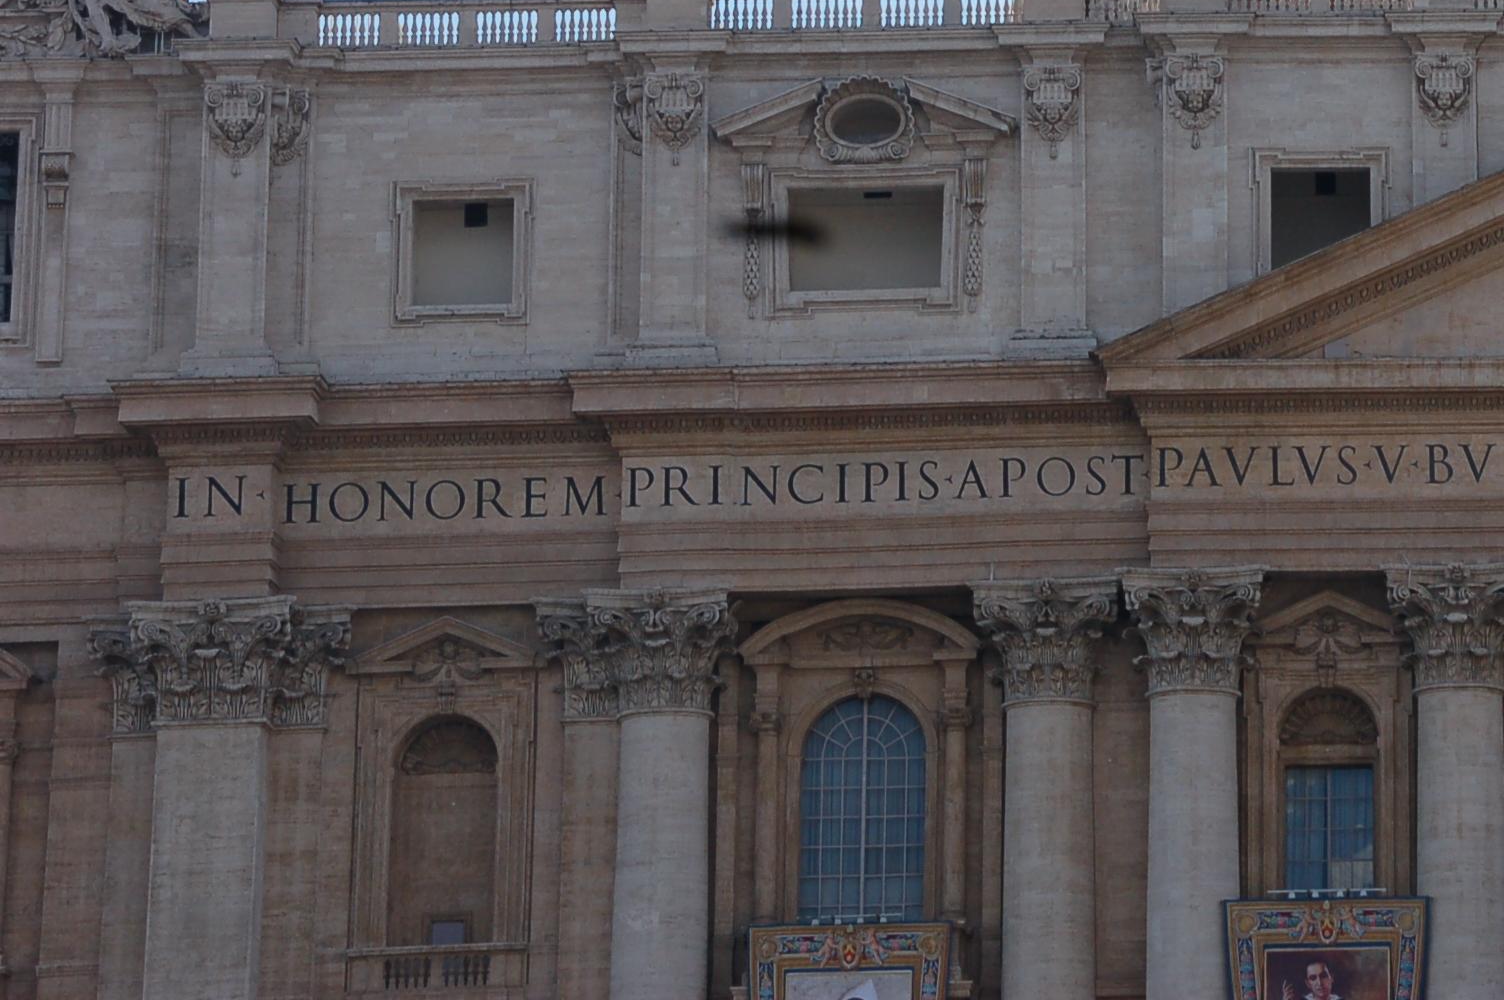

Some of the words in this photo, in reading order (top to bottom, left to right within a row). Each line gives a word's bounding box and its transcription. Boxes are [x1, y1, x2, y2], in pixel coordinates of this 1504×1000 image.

[173, 475, 247, 519] IN
[282, 475, 608, 525] HONOREM
[626, 460, 940, 508] PRINCIPIS
[952, 453, 1145, 498] APOST
[1155, 444, 1360, 488] PAVLVS
[1371, 444, 1410, 485] V
